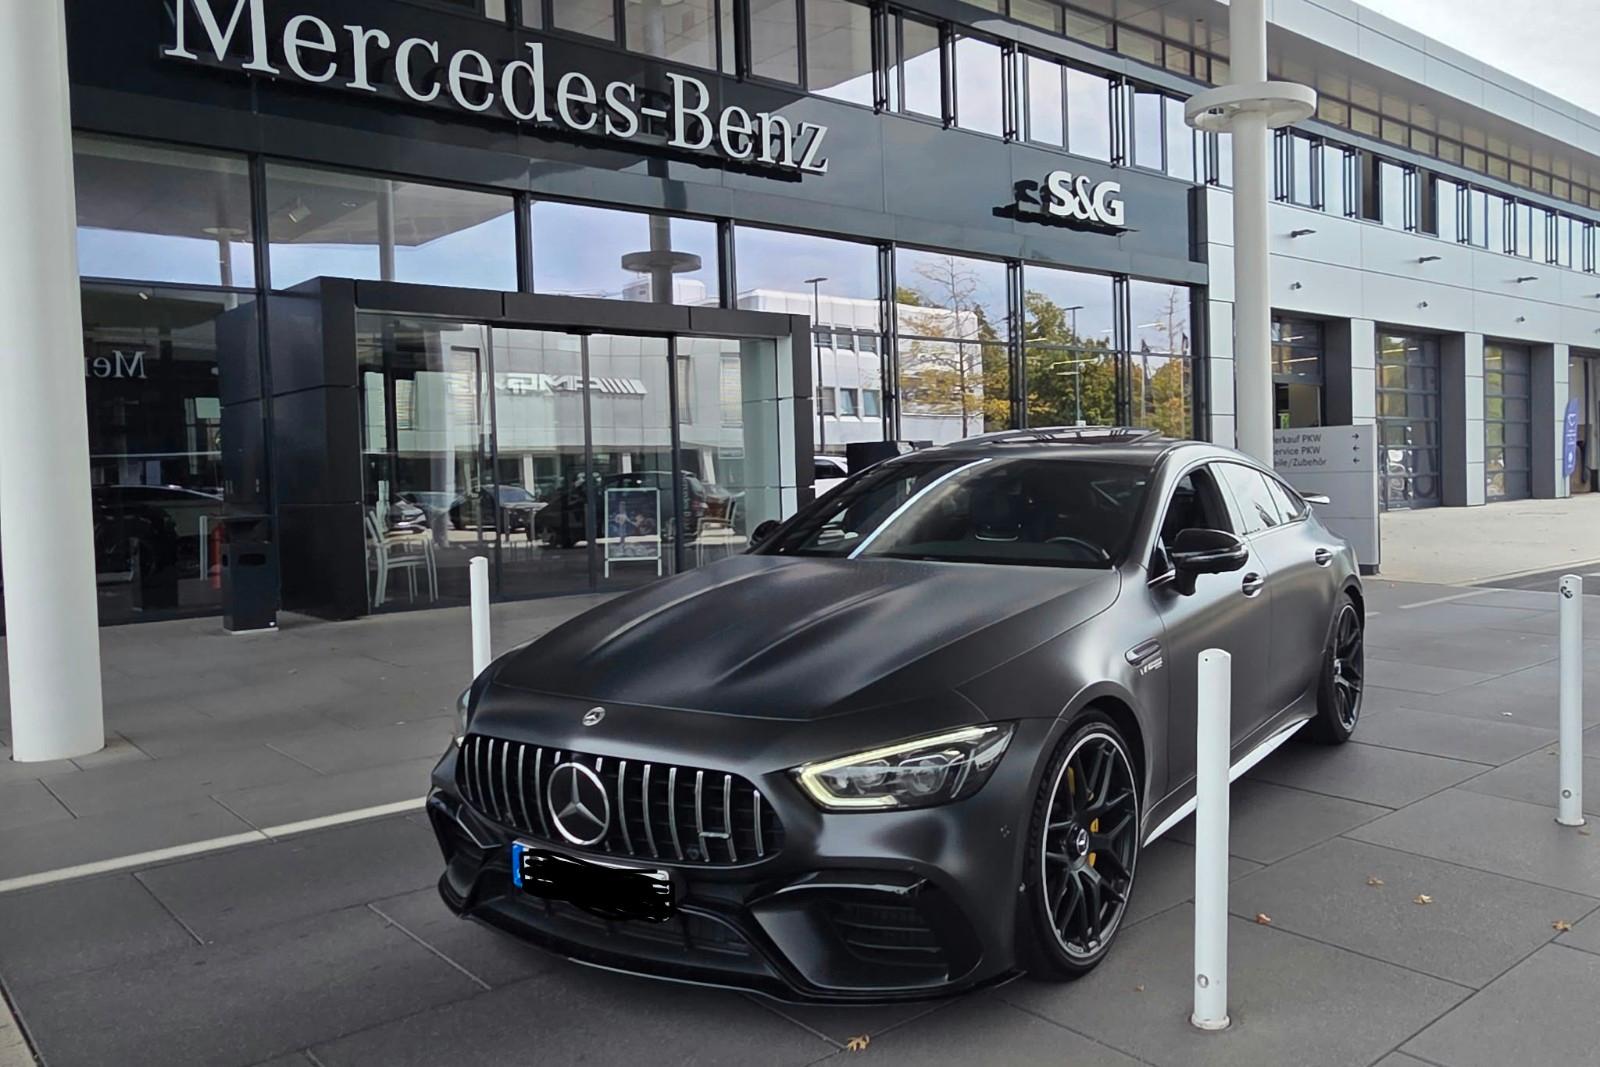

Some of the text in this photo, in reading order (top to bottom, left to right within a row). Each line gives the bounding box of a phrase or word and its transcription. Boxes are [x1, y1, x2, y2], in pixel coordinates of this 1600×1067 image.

[164, 0, 829, 173] Mercedes-Benz
[1048, 170, 1125, 226] S&G
[1274, 433, 1322, 444] erkauf PKW
[1274, 446, 1321, 456] ervice PKW
[1274, 457, 1327, 469] eile/Zubehör
